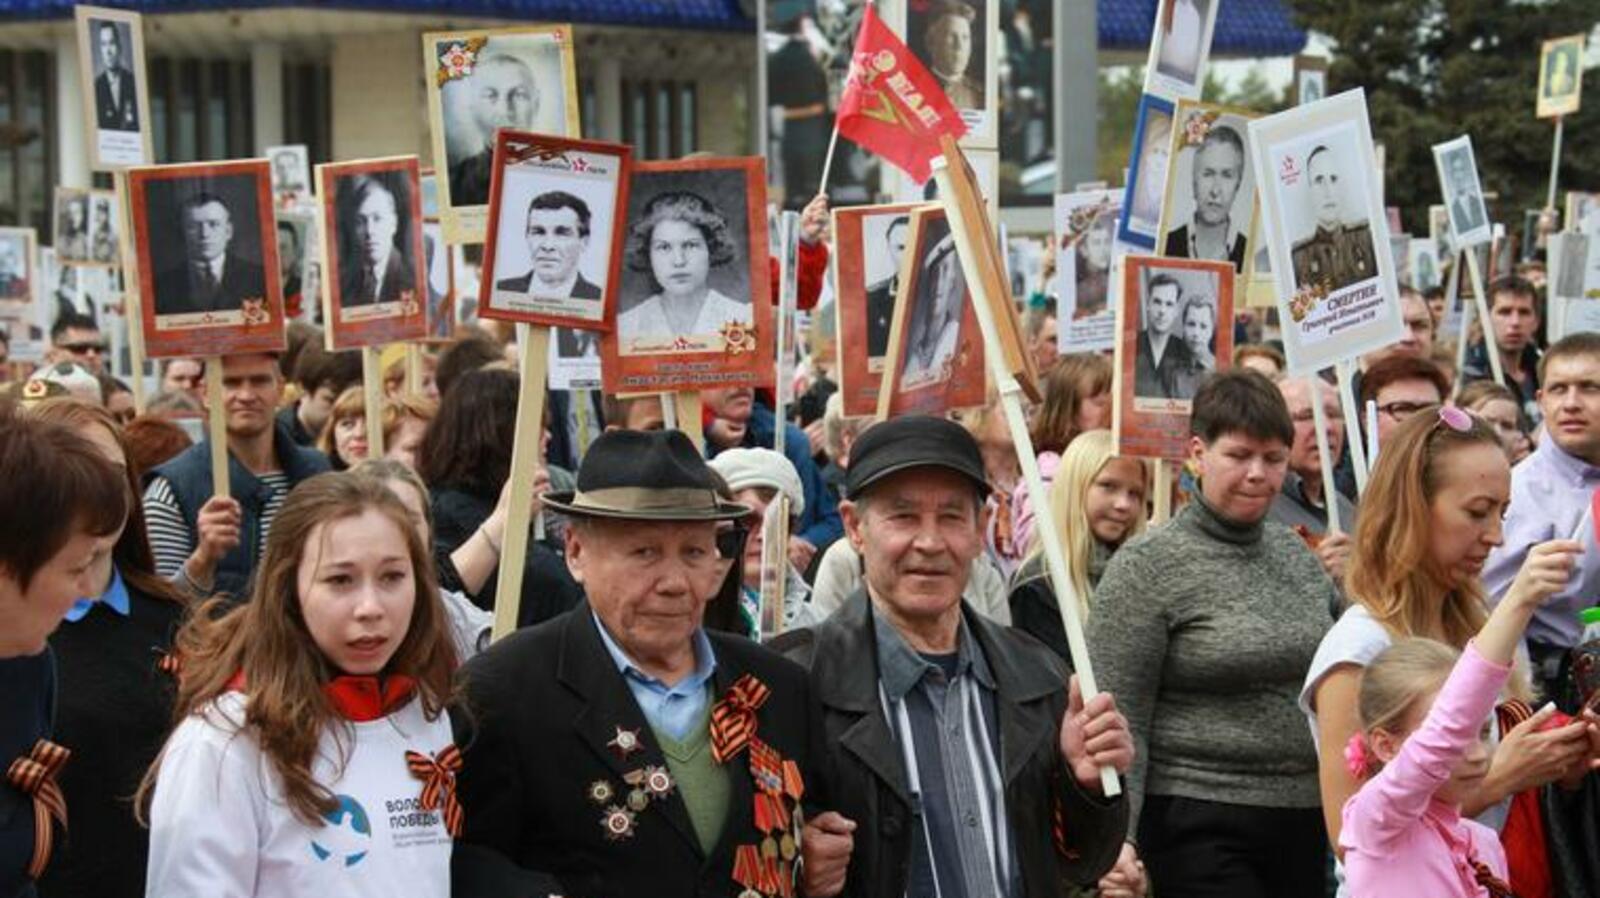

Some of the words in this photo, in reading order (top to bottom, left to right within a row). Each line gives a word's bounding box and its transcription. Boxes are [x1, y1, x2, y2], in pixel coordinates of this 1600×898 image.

[872, 49, 897, 72] 9
[885, 71, 941, 129] МАЯ
[1327, 283, 1377, 311] СМЕРТИН
[389, 812, 439, 829] ПОБЕДЫ
